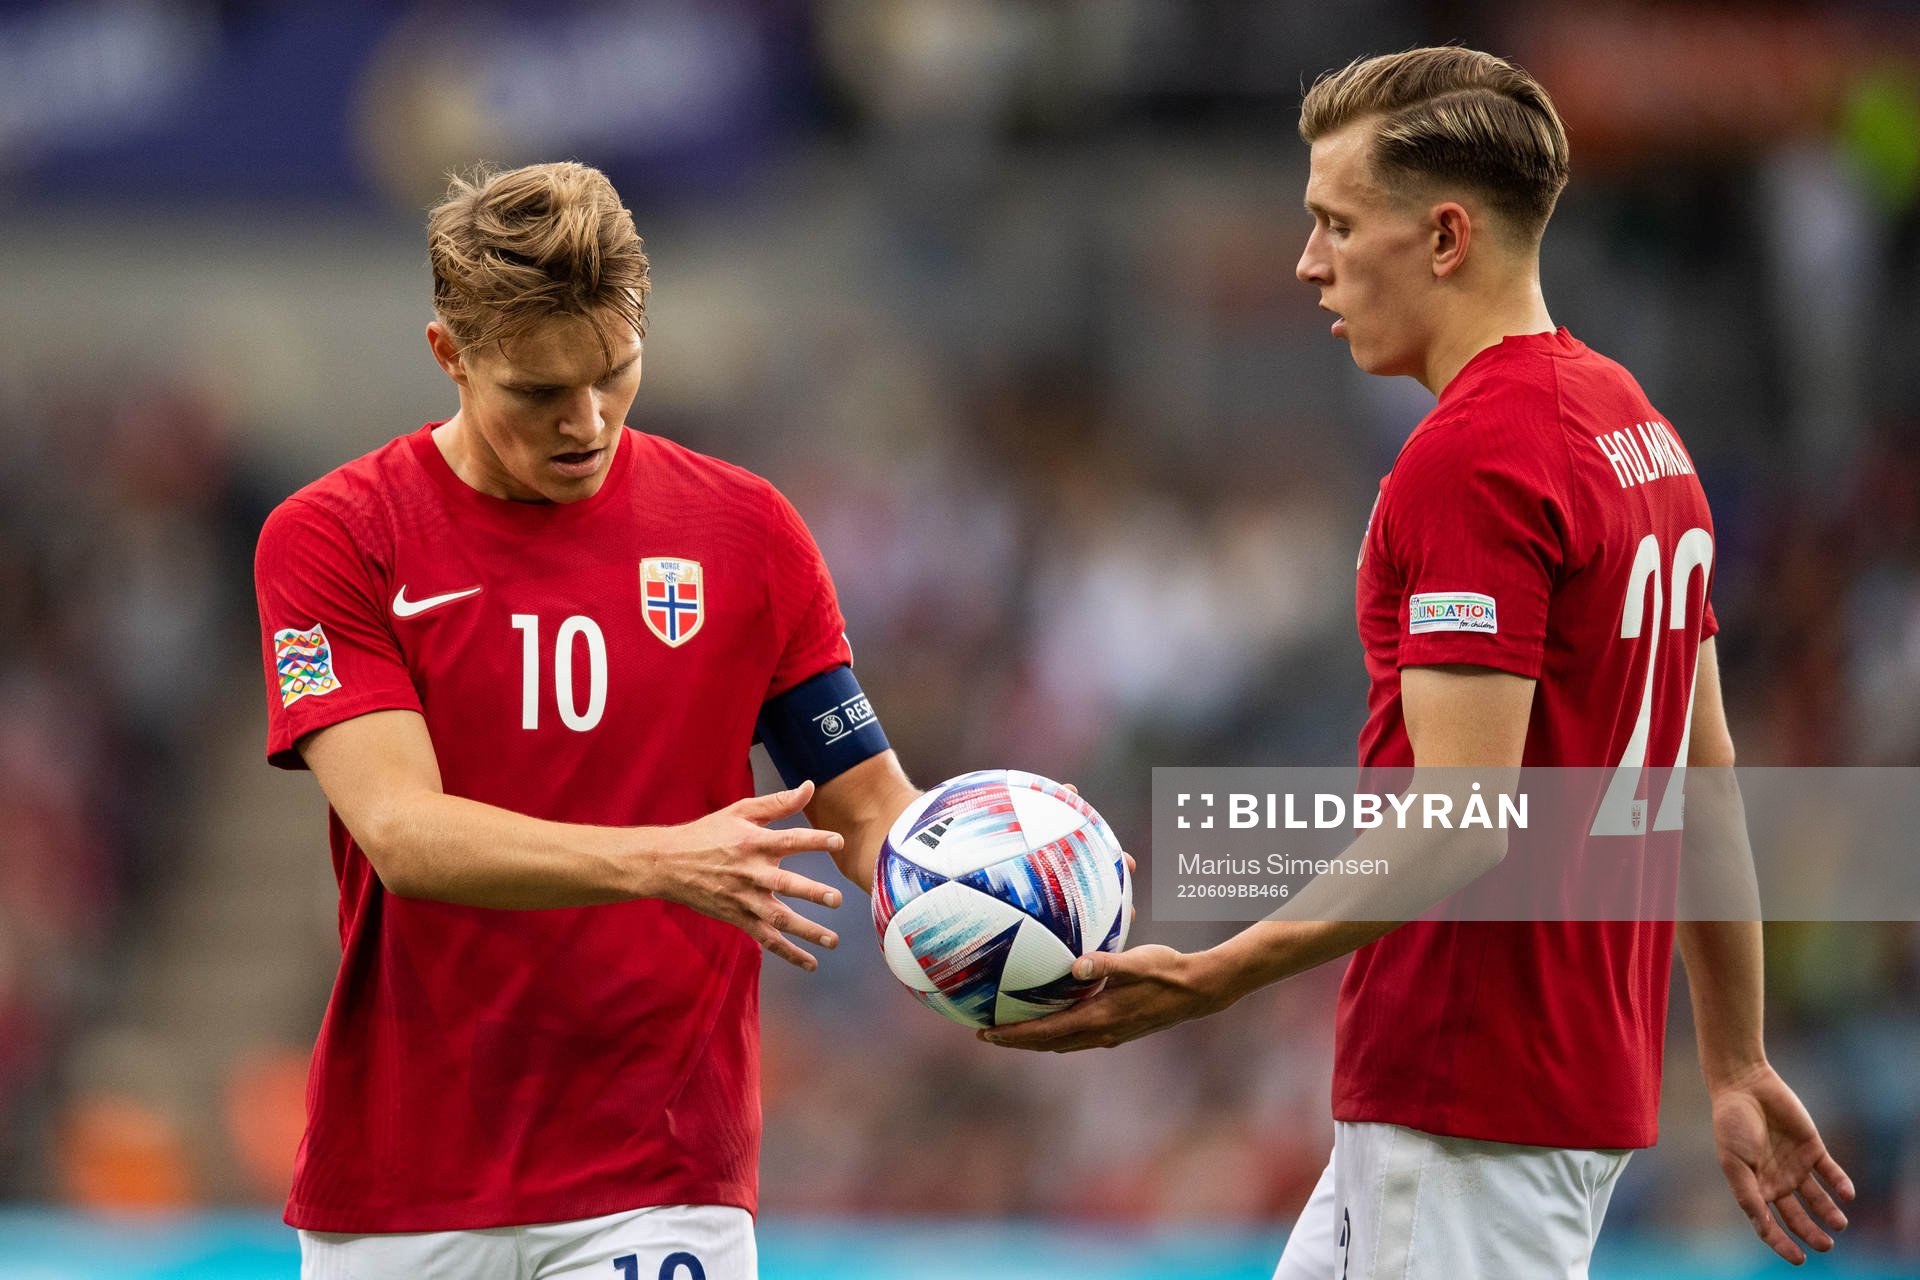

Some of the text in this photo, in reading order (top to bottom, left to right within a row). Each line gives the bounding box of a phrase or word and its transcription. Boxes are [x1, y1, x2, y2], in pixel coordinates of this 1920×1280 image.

[660, 561, 681, 571] NORGE
[1471, 620, 1495, 630] children
[511, 614, 608, 732] 10
[1590, 527, 1713, 836] 22
[844, 698, 875, 724] RES
